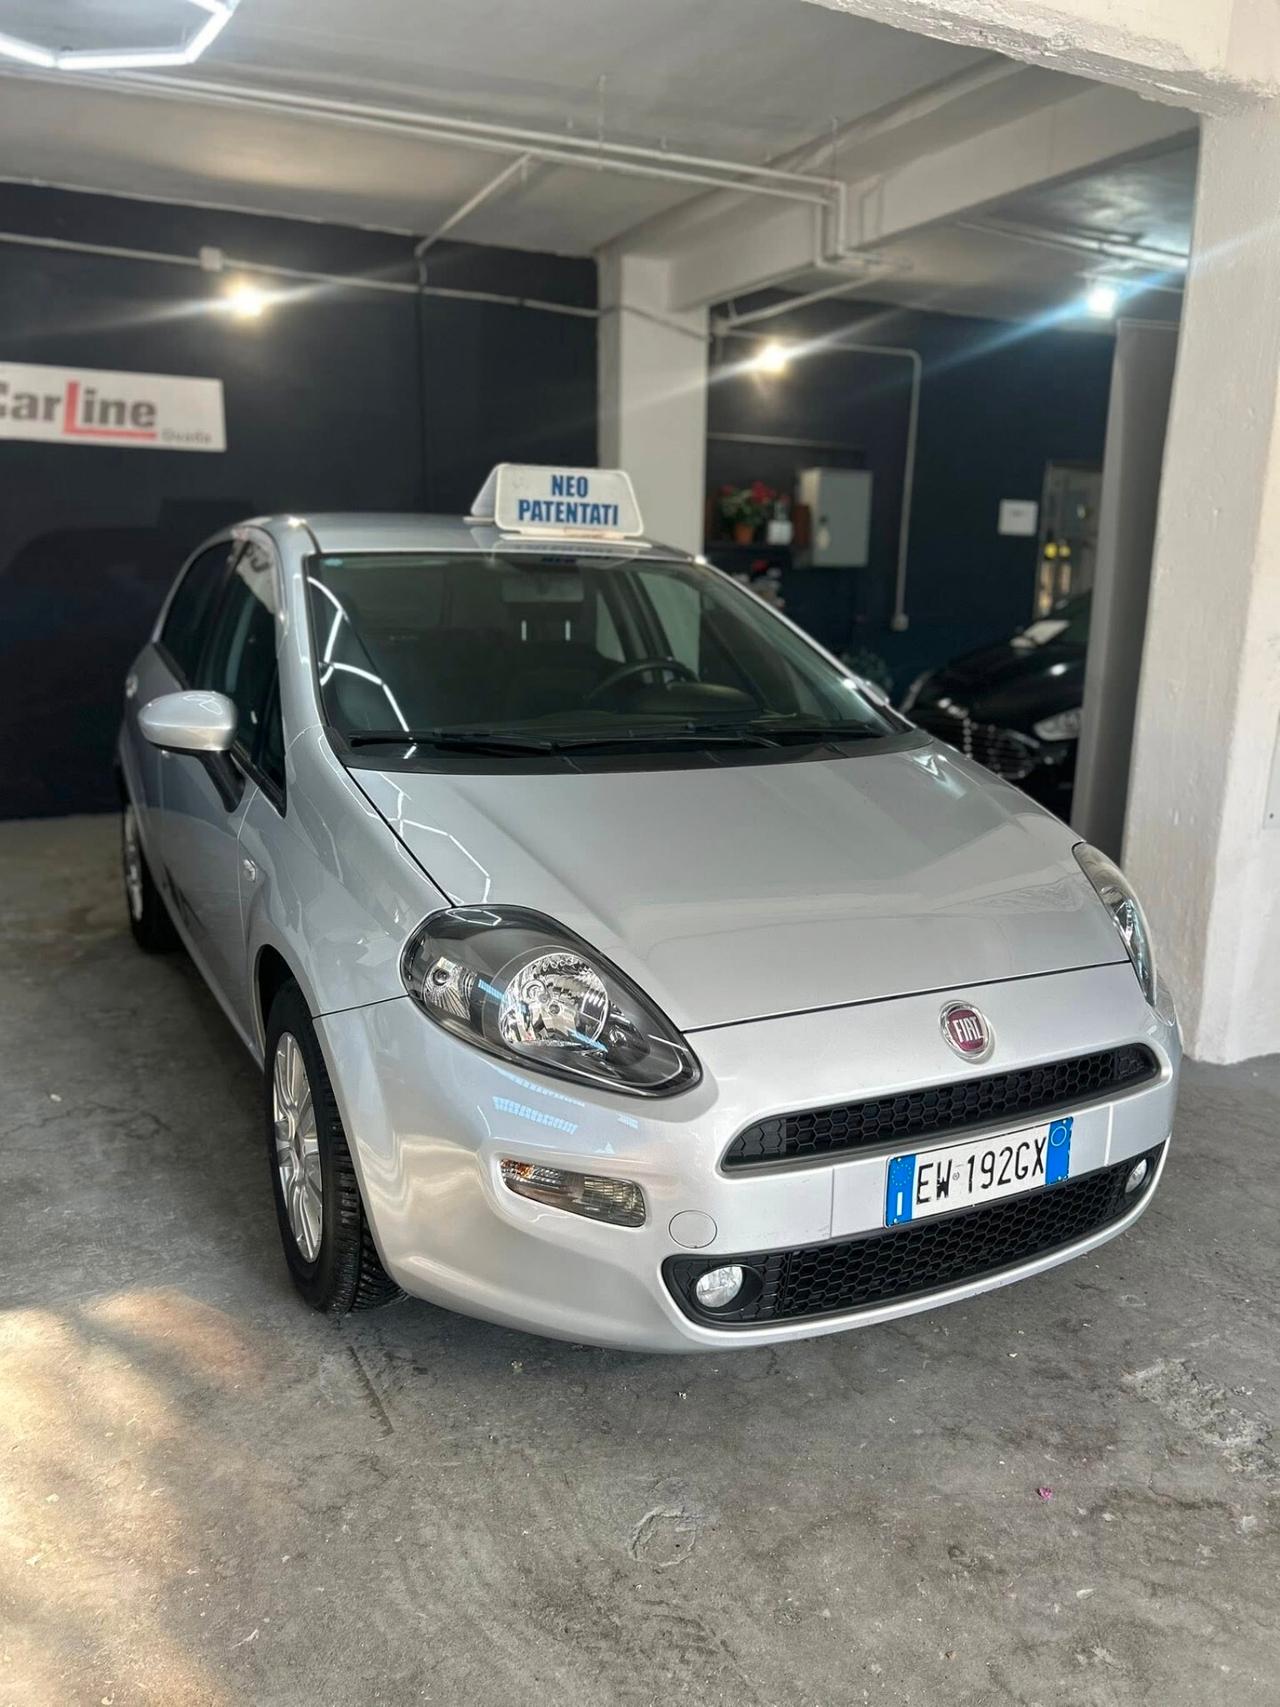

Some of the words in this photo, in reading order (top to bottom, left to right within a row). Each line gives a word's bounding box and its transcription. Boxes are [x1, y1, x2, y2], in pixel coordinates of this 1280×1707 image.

[551, 475, 588, 498] NEO
[517, 499, 619, 526] PATENTATI
[952, 1016, 981, 1043] FIAT
